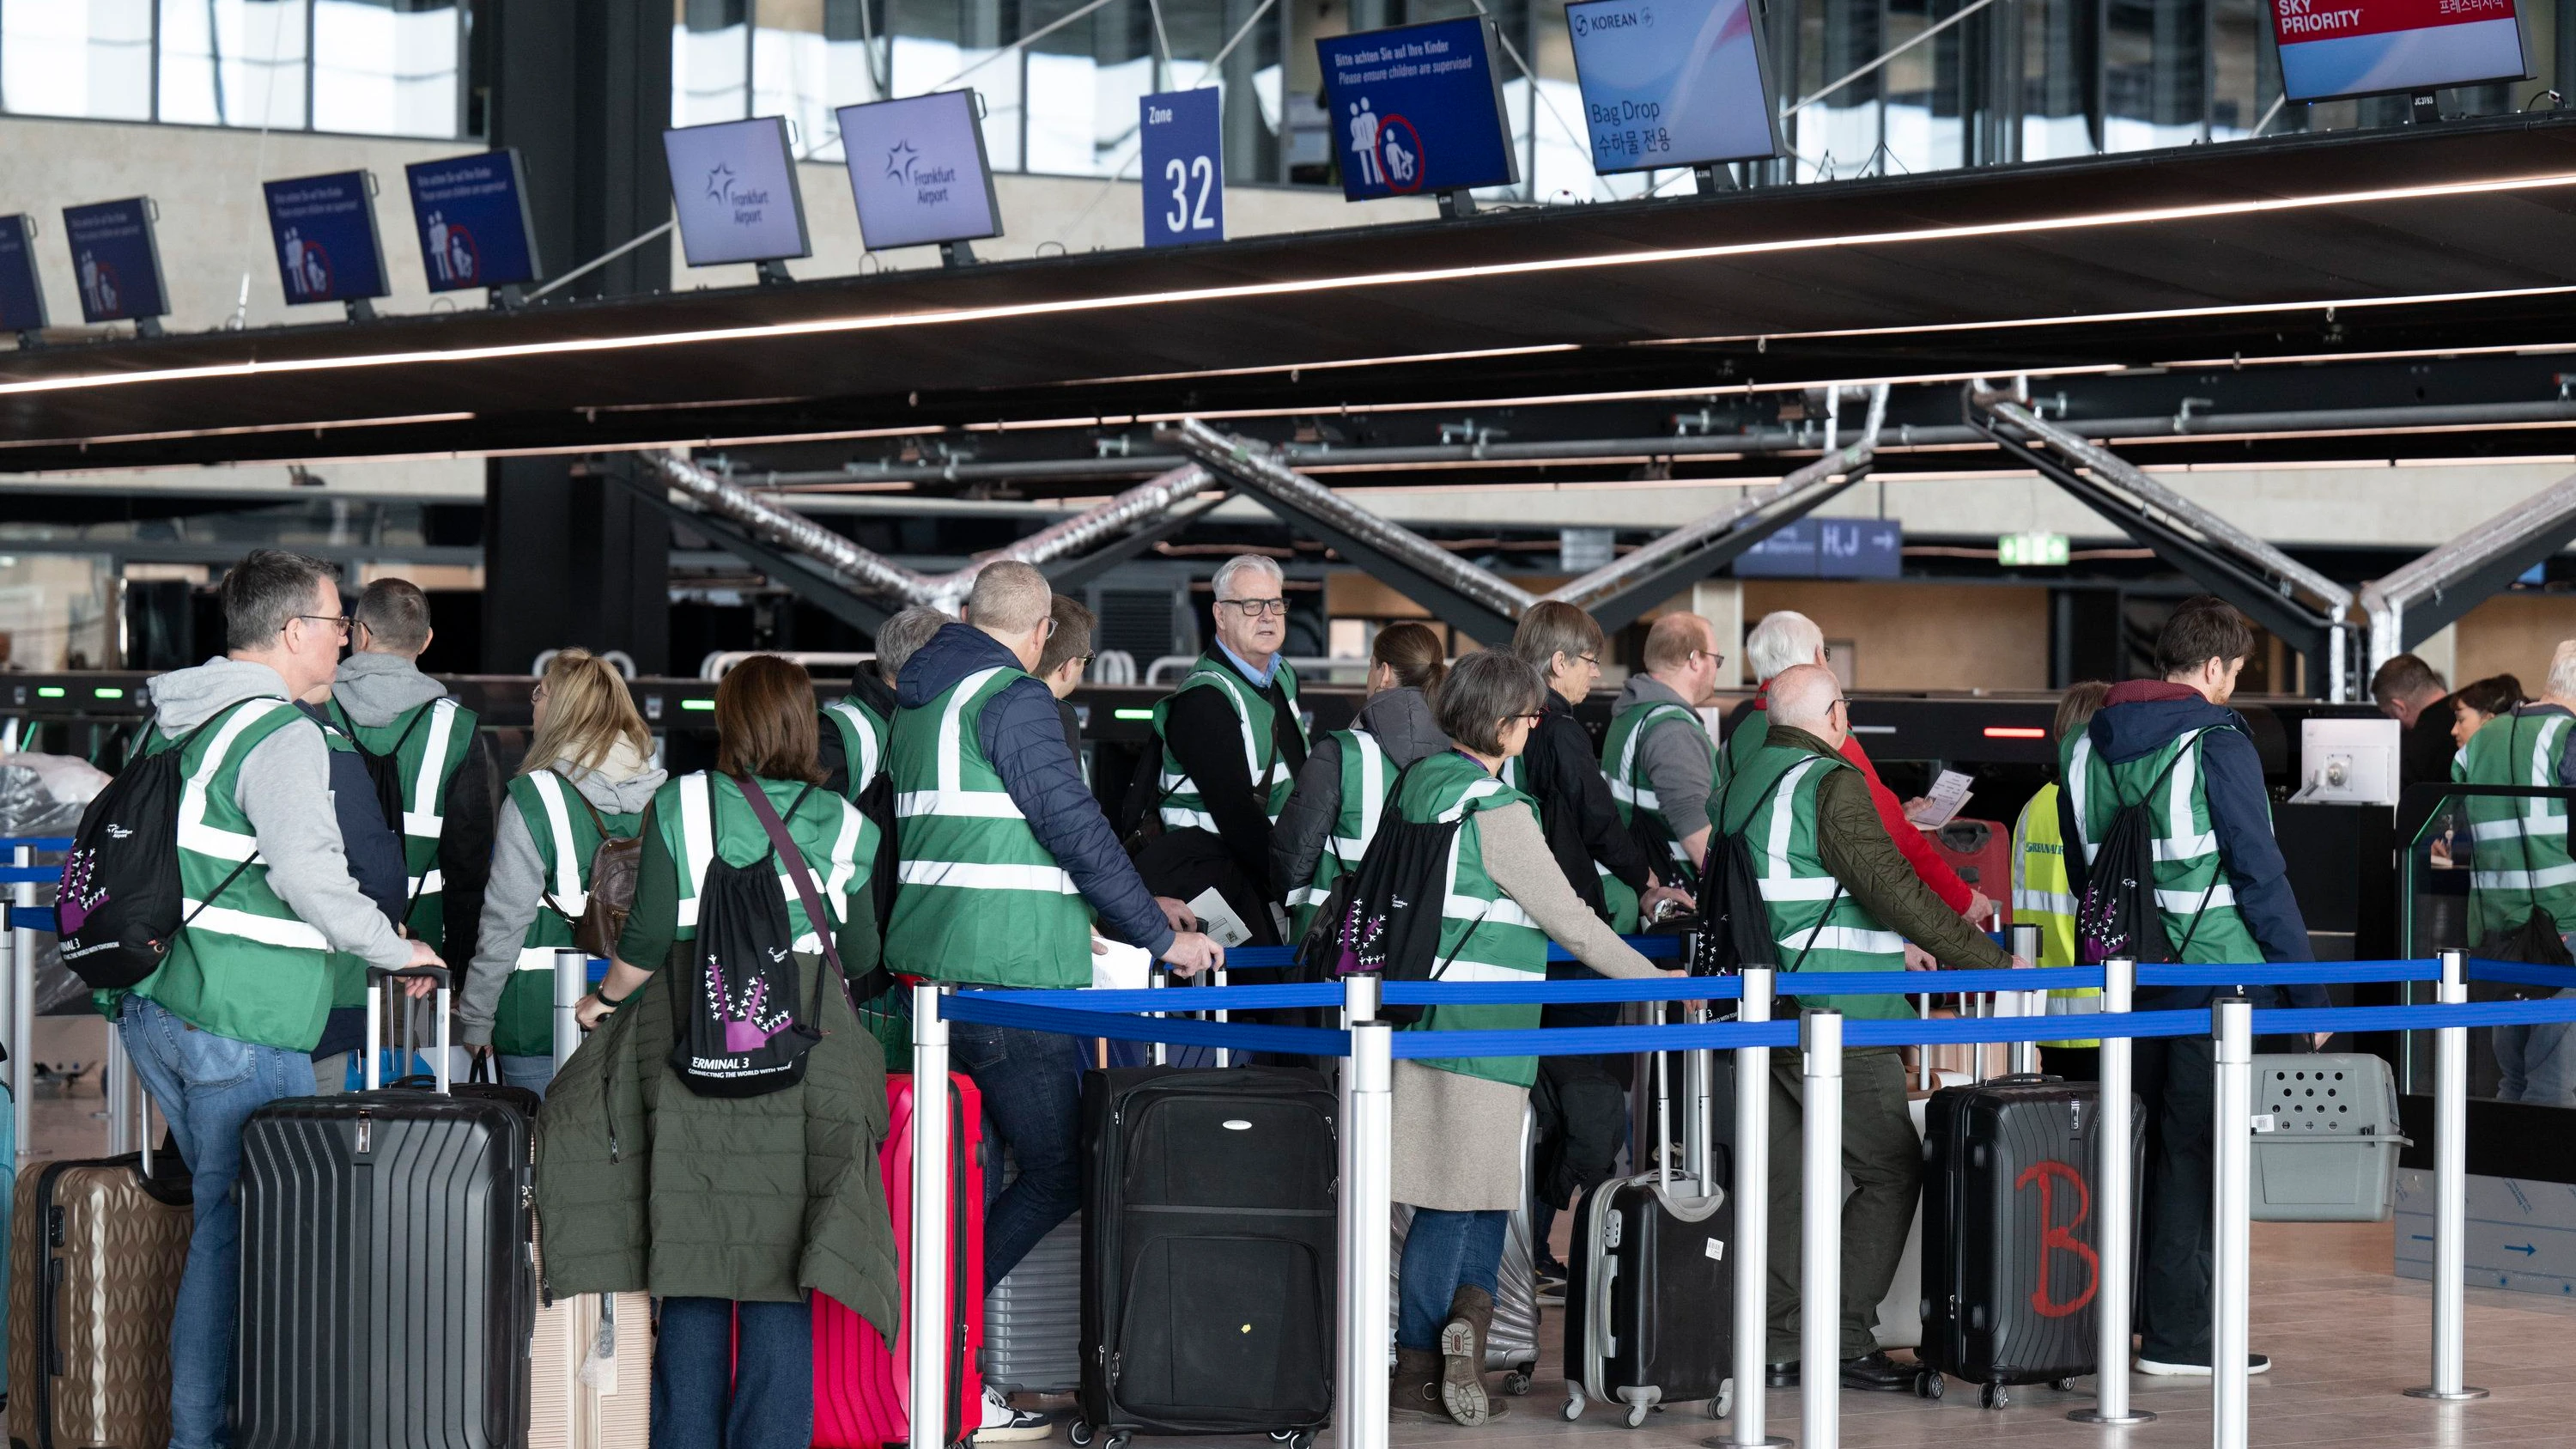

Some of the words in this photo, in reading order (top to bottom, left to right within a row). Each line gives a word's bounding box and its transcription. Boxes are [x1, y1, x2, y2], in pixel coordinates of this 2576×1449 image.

[2278, 0, 2311, 15] SKY
[1591, 12, 1637, 30] KOREAN
[2281, 9, 2360, 34] PRIORITY
[1334, 53, 1354, 67] Bitte
[1354, 51, 1380, 64] achten
[1380, 47, 1393, 61] Sie
[1394, 45, 1406, 59] auf
[1407, 43, 1424, 57] Ihre
[1424, 40, 1449, 54] Kinder
[1339, 71, 1362, 85] Please
[1363, 69, 1388, 82] ensure
[1388, 64, 1418, 79] children
[1419, 63, 1431, 75] are
[1432, 55, 1473, 75] supervised
[1148, 106, 1173, 125] Zone
[1591, 103, 1621, 126] Bag
[1622, 100, 1660, 122] Drop
[1599, 131, 1639, 157] 수하물
[1643, 127, 1672, 153] 전용
[914, 166, 957, 186] Frankfurt
[731, 189, 769, 205] Frankfurt
[917, 187, 949, 207] Airport
[1165, 155, 1215, 233] 32
[734, 210, 762, 227] Airport
[75, 937, 81, 948] 3
[1707, 1008, 1713, 1018] 3
[743, 1057, 750, 1068] 3
[688, 1068, 725, 1078] CONNECTING
[2015, 1160, 2099, 1317] B
